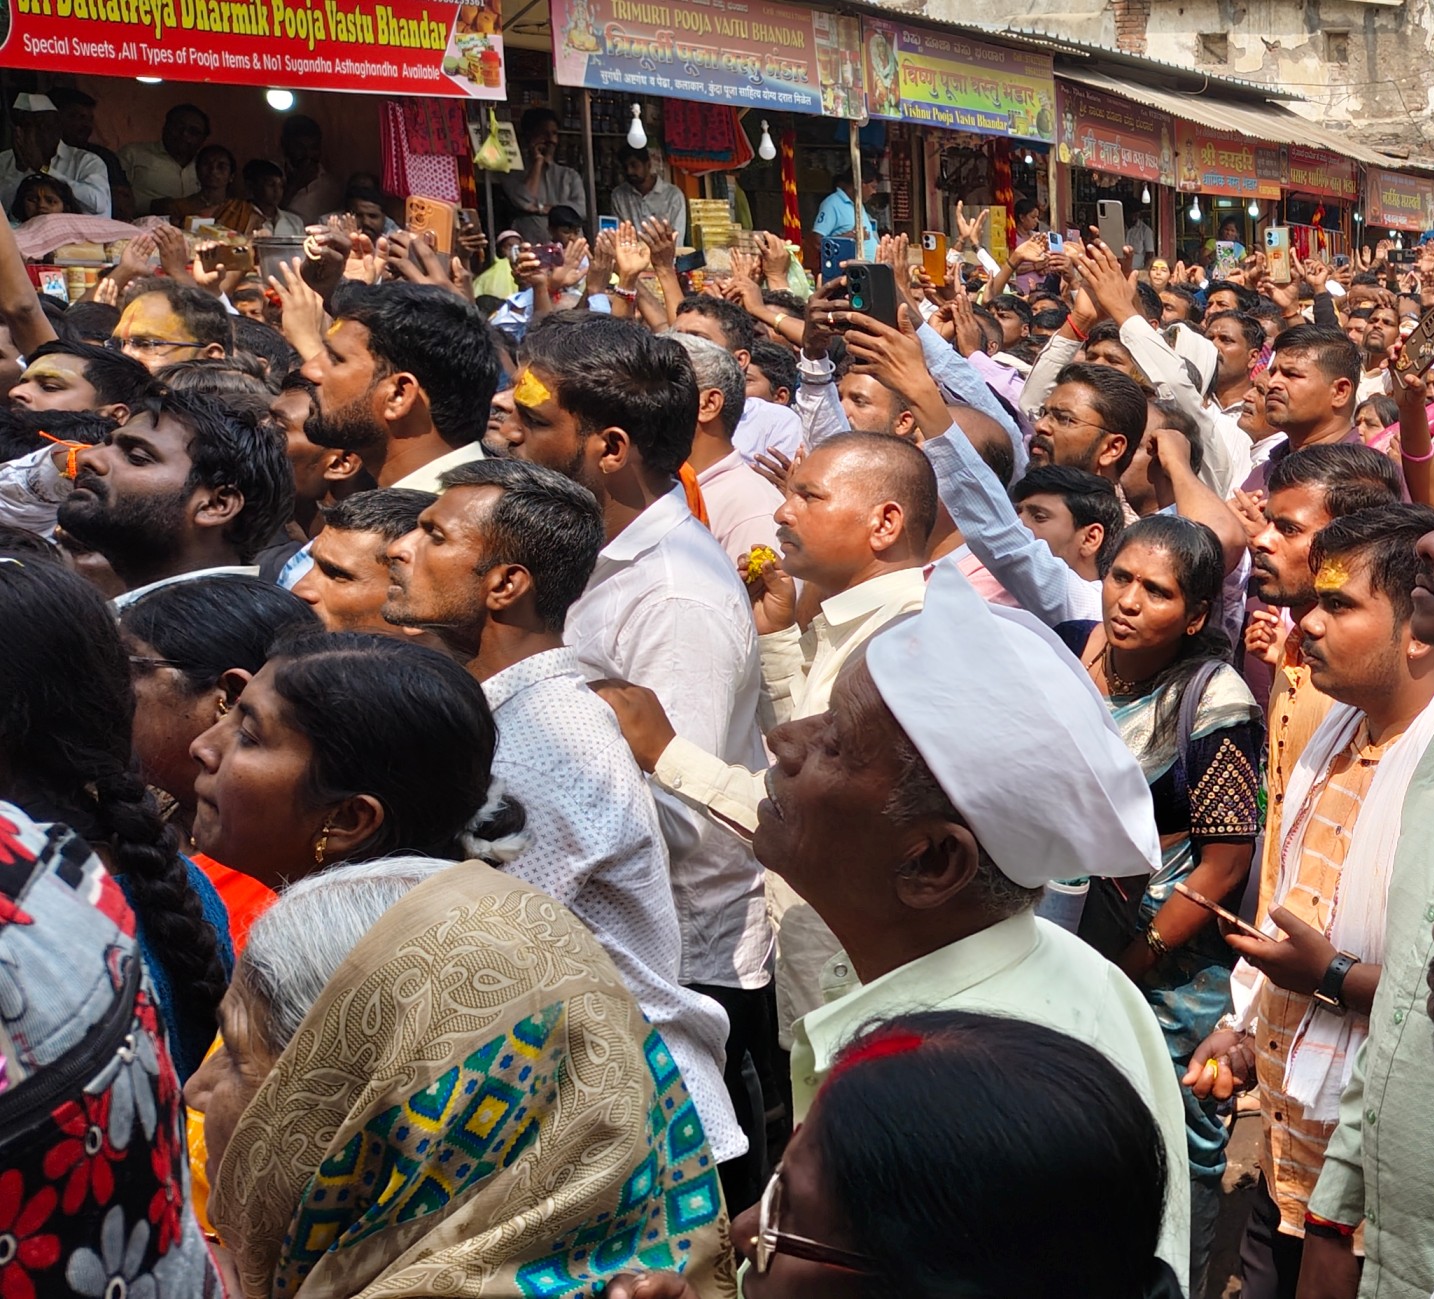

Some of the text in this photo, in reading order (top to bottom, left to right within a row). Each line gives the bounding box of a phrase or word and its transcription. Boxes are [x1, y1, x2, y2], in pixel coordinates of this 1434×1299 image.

[181, 0, 270, 36] Dharmik
[271, 0, 326, 51] Pooja
[325, 0, 375, 44] Vastu
[375, 4, 447, 50] Bhandar
[611, 0, 805, 48] TRIMURTI POOJA VASTU BHANDAR
[23, 33, 70, 57] Special
[72, 37, 115, 59] Sweets
[139, 43, 174, 66] Types
[175, 47, 187, 64] of
[189, 48, 220, 70] Pooja
[221, 51, 250, 69] Items
[252, 53, 261, 70] &
[285, 55, 333, 75] Sugandha
[334, 58, 399, 78] Asthaghandha
[402, 63, 441, 80] Available
[675, 41, 719, 77] पूजा
[720, 48, 764, 85] वस्तु
[765, 47, 808, 83] भंडार
[901, 58, 939, 99] विष्णु
[940, 70, 969, 103] पूजा
[970, 77, 1002, 109] वस्तु
[903, 102, 1007, 131] Vishnu Pooja Vastu Bhandar
[1081, 128, 1096, 162] श्री
[1201, 142, 1216, 166] श्री
